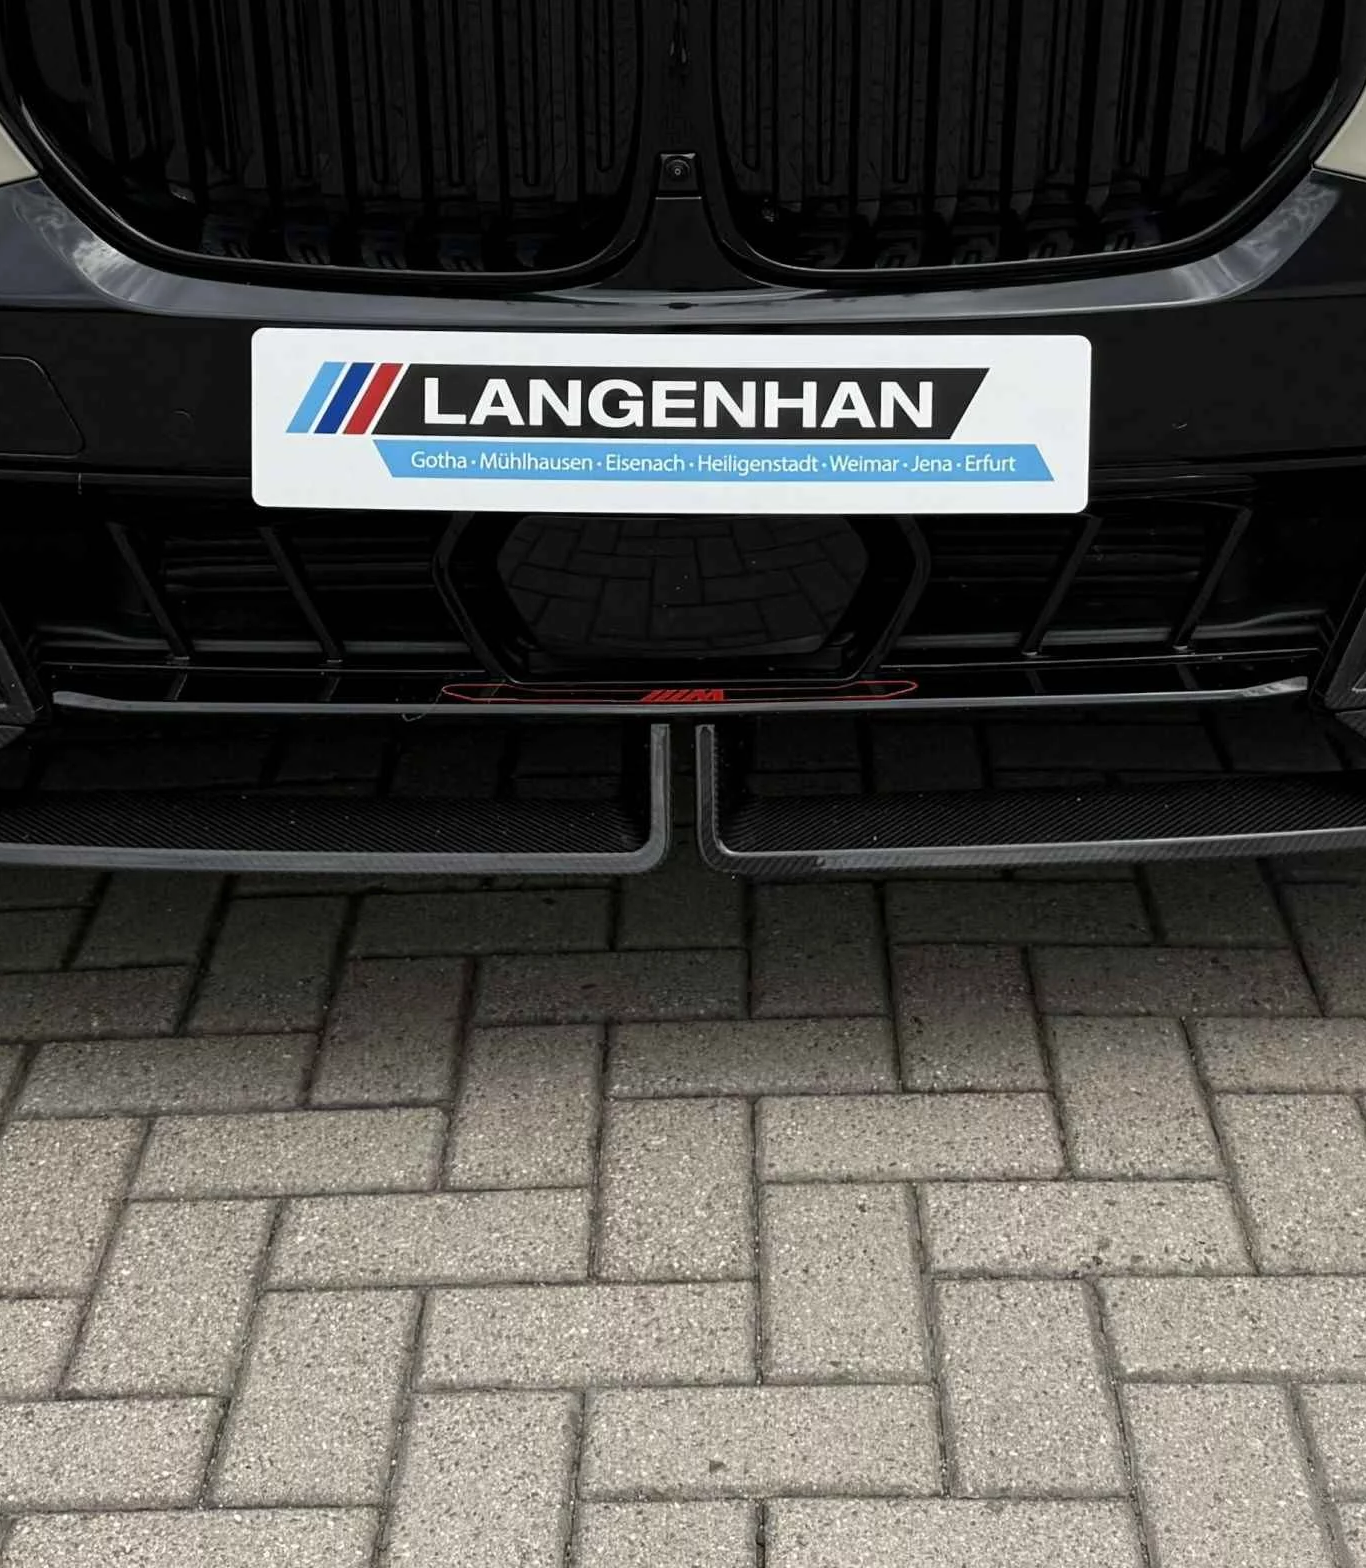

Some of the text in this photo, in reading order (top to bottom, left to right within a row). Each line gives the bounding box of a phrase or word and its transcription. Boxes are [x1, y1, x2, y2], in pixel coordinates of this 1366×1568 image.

[424, 377, 933, 428] LANGENHAN
[411, 451, 1016, 476] Gotha Mühlhausen Eisenach Heiligenstadt Weimar Jena Erfurt
